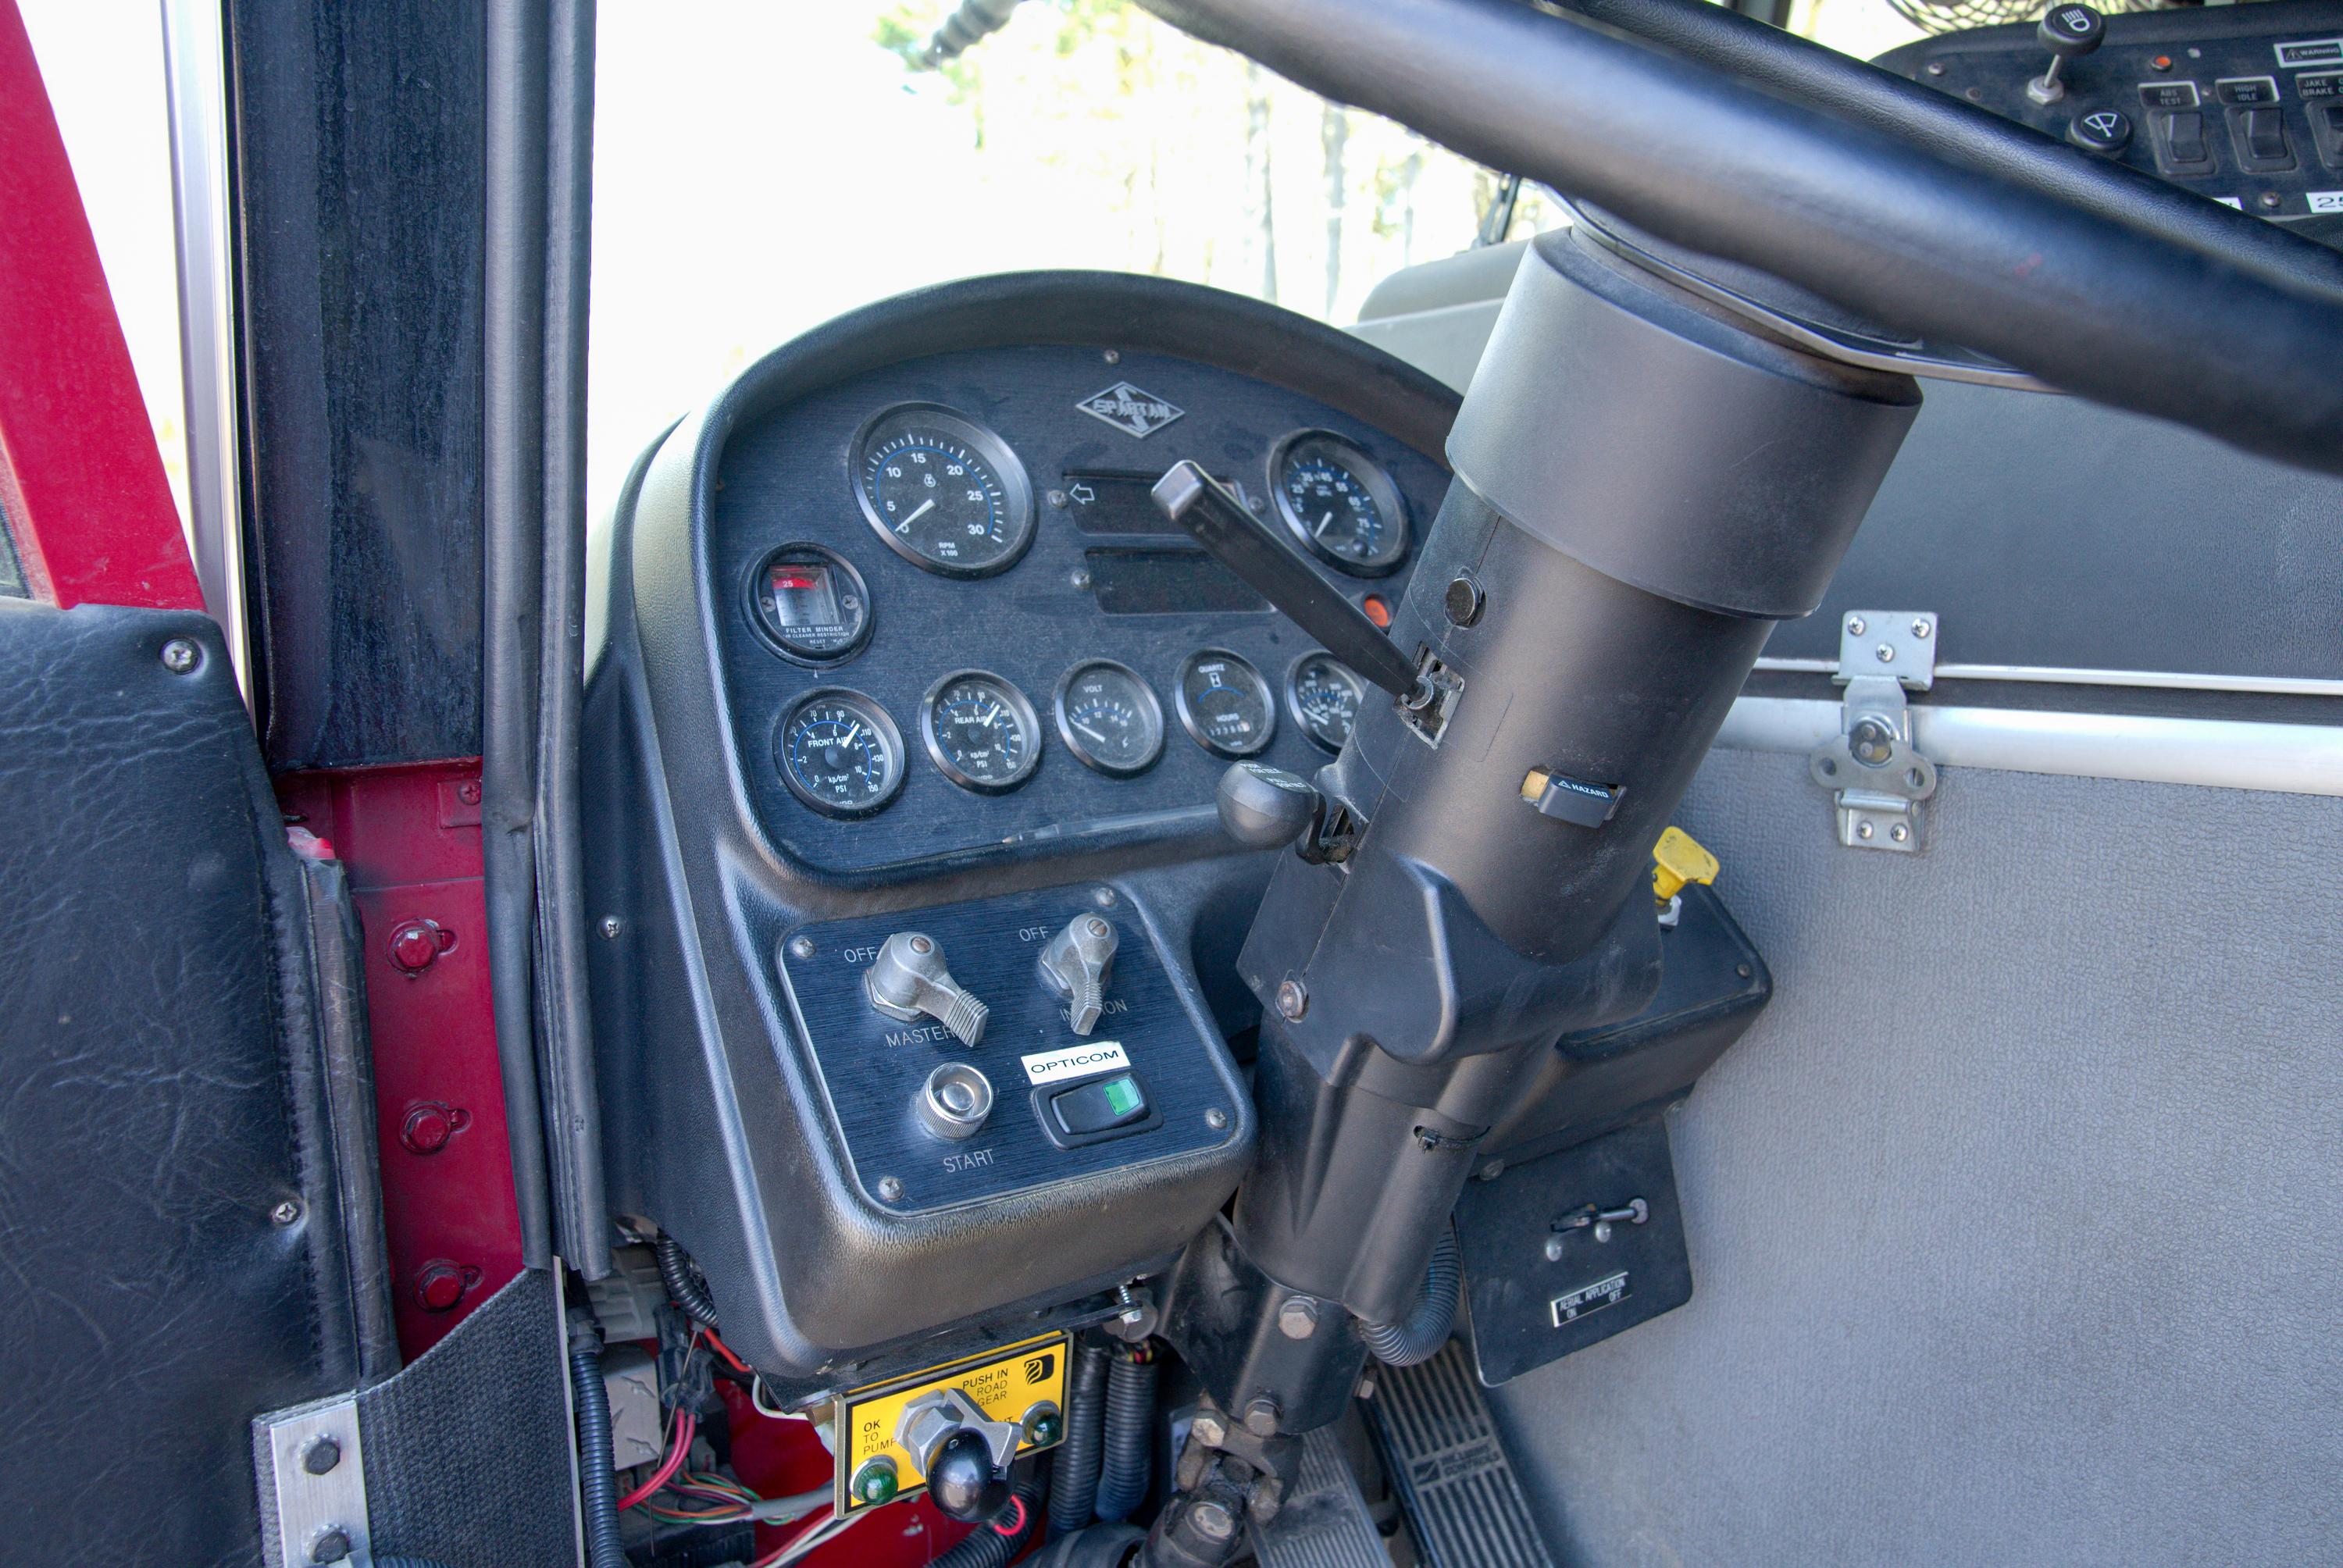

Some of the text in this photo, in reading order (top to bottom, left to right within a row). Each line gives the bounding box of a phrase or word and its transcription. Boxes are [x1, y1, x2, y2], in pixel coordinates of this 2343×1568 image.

[2299, 48, 2340, 56] WARNING
[2302, 87, 2334, 96] BRAKE
[911, 453, 926, 463] 15
[886, 467, 901, 478] 10
[947, 465, 964, 476] 20
[967, 490, 984, 501] 25
[886, 501, 896, 511] 5
[968, 524, 984, 535] 30
[1216, 713, 1239, 722] HOURS
[808, 739, 833, 748] FRONT
[1571, 784, 1609, 797] HAZARD
[1019, 926, 1049, 942] OFF
[844, 946, 877, 963] OFF
[1031, 1050, 1119, 1074] OPTICOM
[943, 1149, 993, 1173] START
[1560, 1278, 1626, 1311] AERIAL APPLICATION
[1609, 1288, 1622, 1303] OFF
[1567, 1307, 1578, 1320] ON
[963, 1368, 1008, 1390] PUSH IN
[977, 1380, 1007, 1396] ROAD
[977, 1391, 1007, 1406] GEAR
[864, 1419, 880, 1432] OK
[863, 1431, 879, 1444] TO
